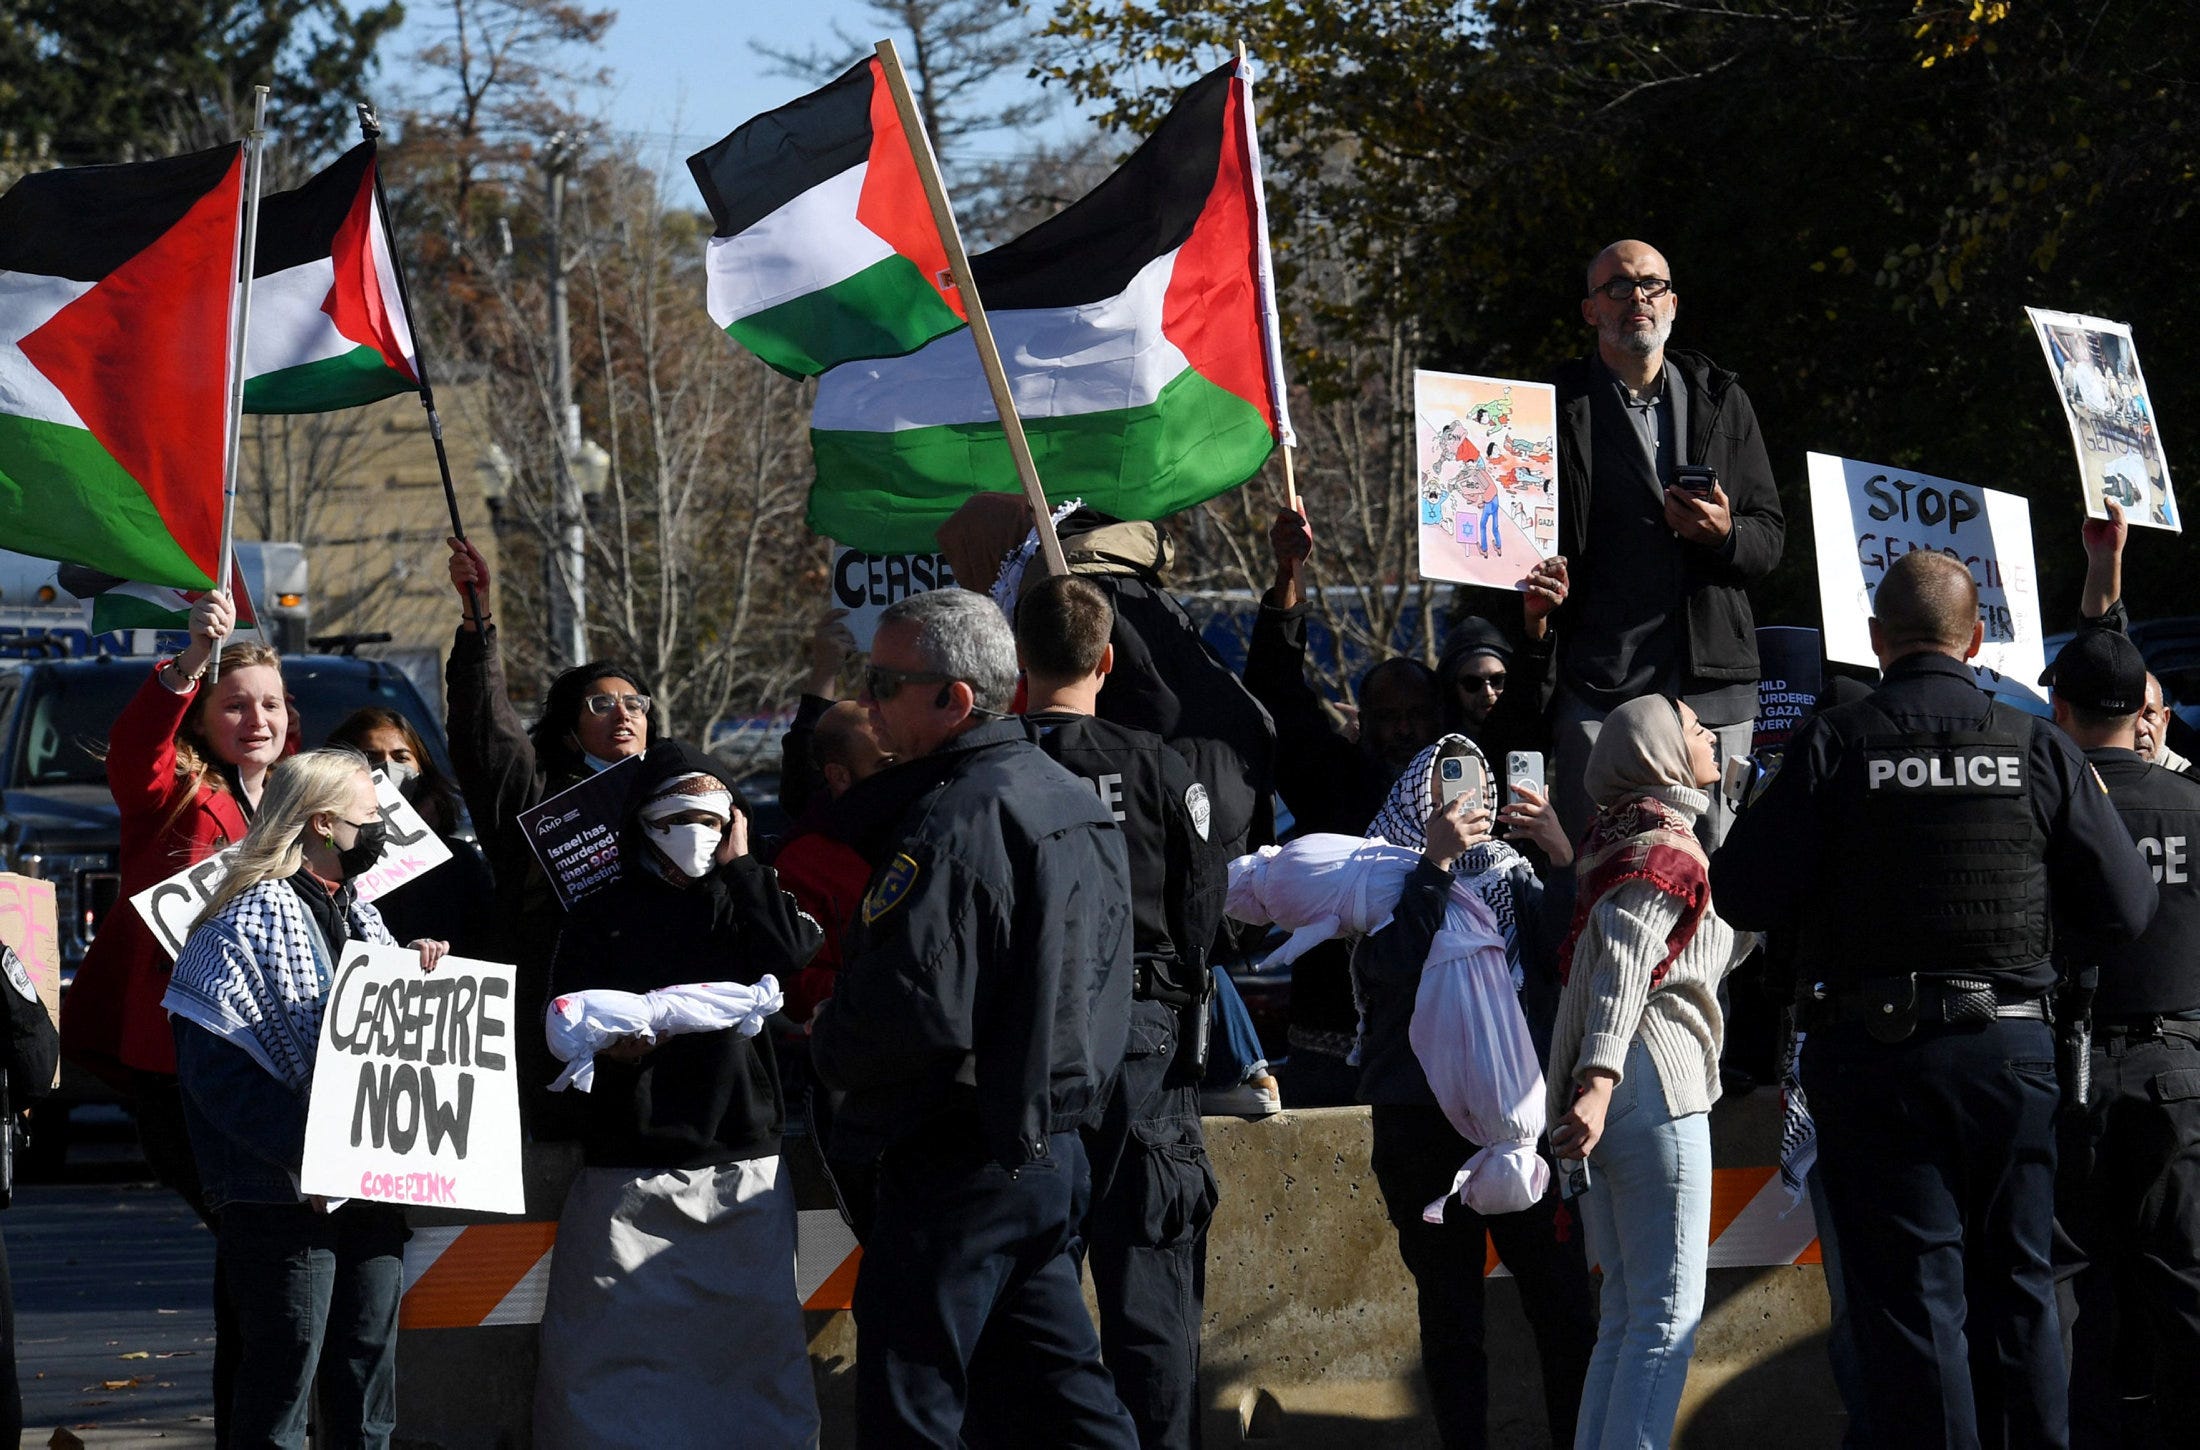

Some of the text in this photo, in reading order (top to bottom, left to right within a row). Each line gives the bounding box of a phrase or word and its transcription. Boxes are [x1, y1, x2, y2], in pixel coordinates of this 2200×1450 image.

[1864, 474, 1981, 534] STOP
[1765, 705, 1802, 717] GAZA
[1868, 755, 2022, 790] POLICE
[538, 817, 562, 836] AMP
[547, 823, 607, 859] Israel has
[554, 833, 615, 871] murdered
[560, 862, 591, 882] than
[330, 953, 509, 1071] CEASEFIRE
[350, 1060, 475, 1160] NOW
[360, 1170, 457, 1204] CODEPINK
